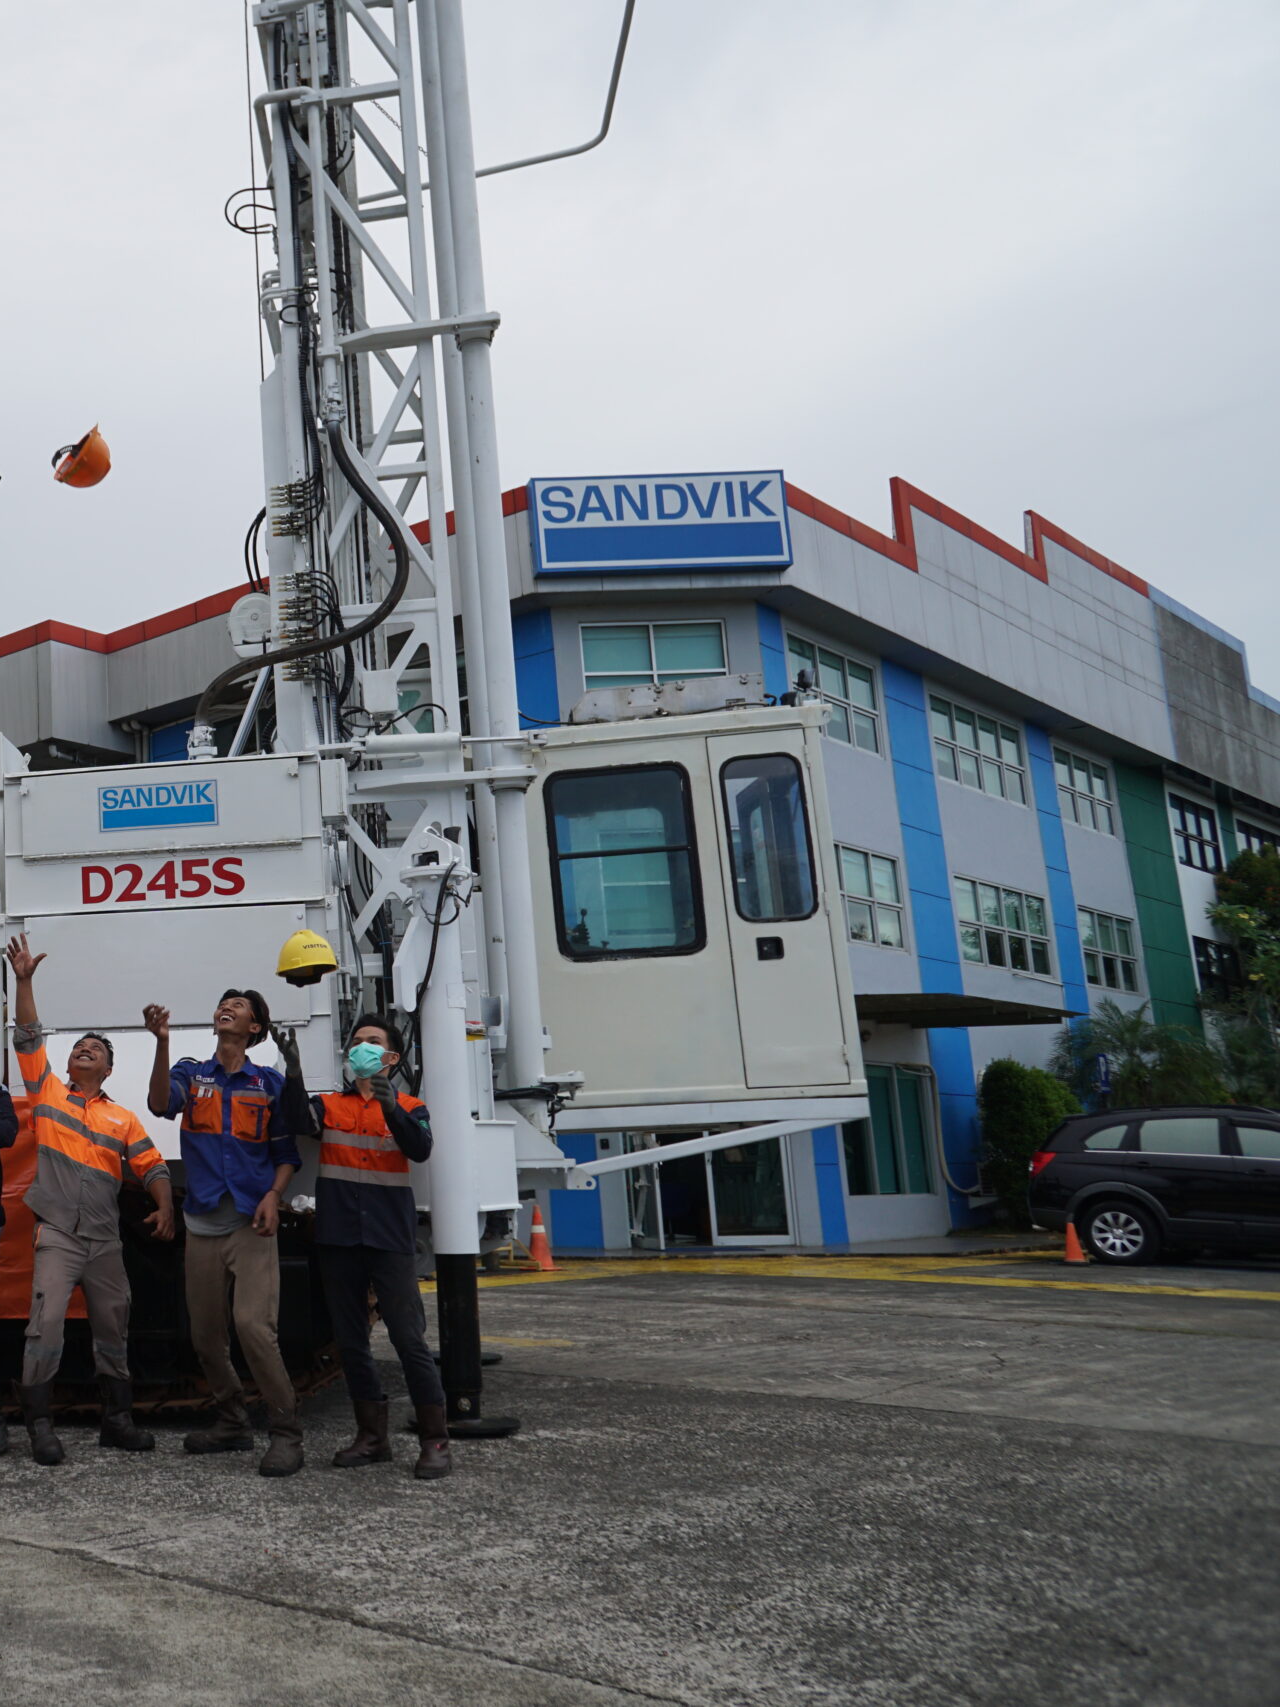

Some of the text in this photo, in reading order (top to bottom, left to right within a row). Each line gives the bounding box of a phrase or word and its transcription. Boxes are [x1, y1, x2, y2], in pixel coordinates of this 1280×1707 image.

[540, 479, 777, 524] SANDVIK
[102, 783, 215, 810] SANDVIK
[81, 857, 246, 905] D245S
